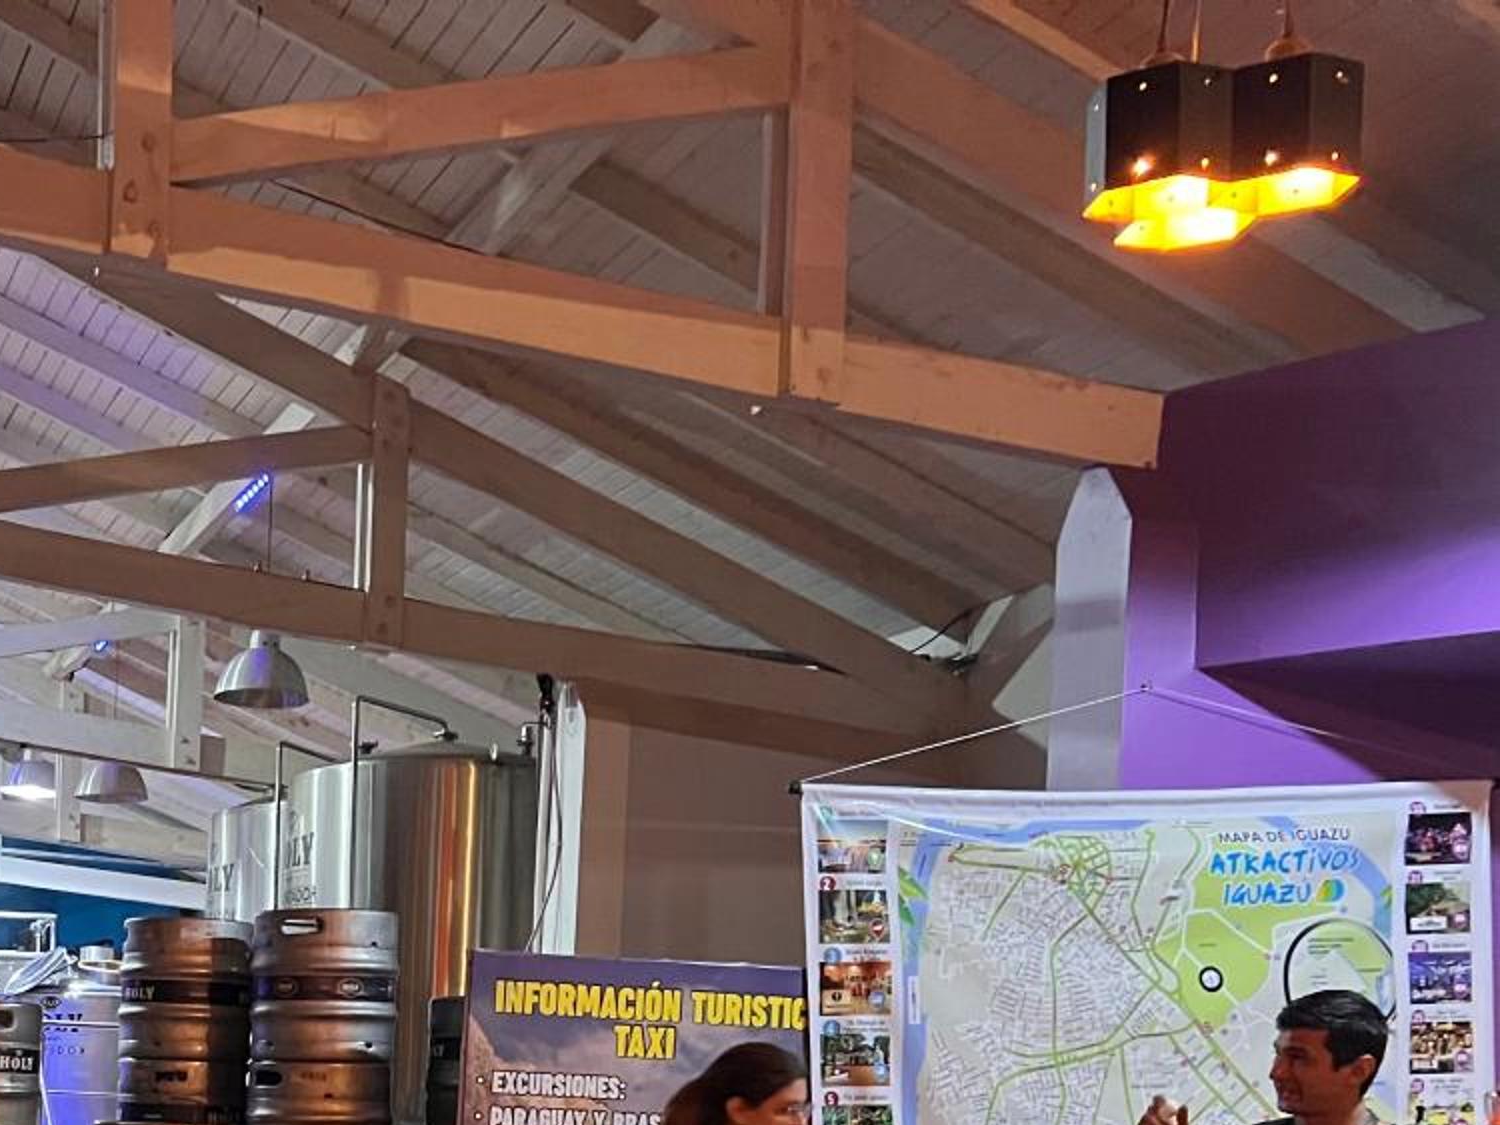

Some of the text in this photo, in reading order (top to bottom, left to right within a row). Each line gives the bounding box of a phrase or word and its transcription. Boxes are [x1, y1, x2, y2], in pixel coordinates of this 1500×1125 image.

[494, 979, 683, 1023] INFORMACIÓN
[613, 1025, 676, 1059] TAXI
[492, 1072, 627, 1100] EXCURSIONES:
